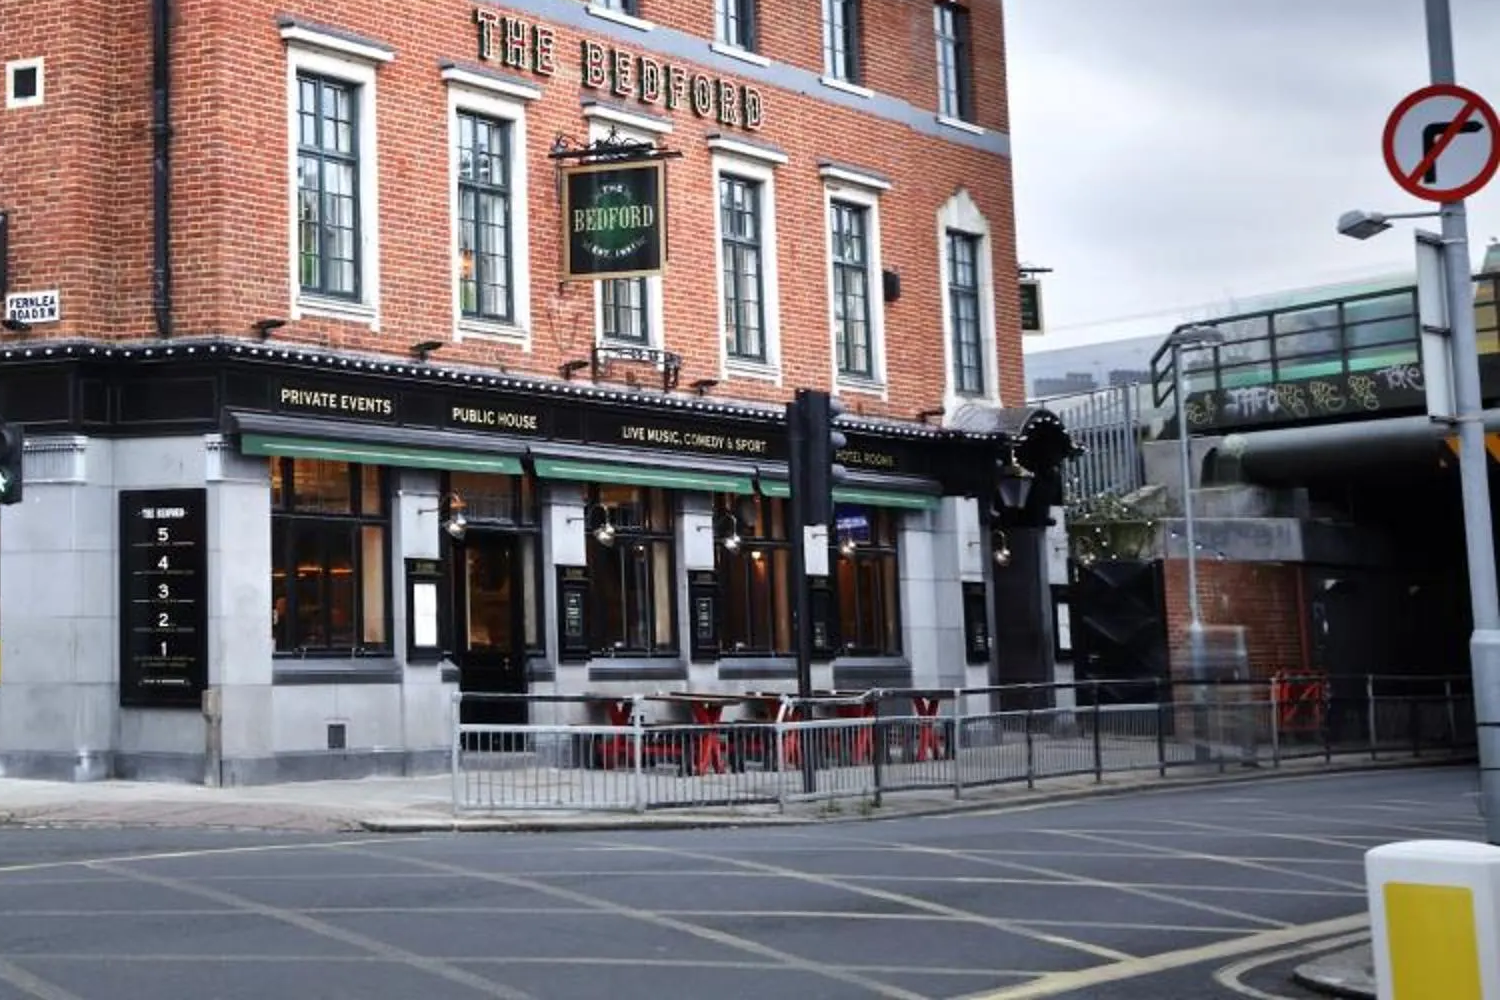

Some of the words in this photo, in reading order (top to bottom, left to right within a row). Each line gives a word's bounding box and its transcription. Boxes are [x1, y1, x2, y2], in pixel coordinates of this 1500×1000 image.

[477, 7, 556, 75] THE
[581, 39, 763, 131] BEDFORD
[573, 204, 654, 232] BEDFORD
[9, 295, 55, 309] FERNLEA
[281, 388, 337, 409] PRIVATE
[341, 395, 391, 415] EVENTS
[452, 407, 495, 425] PUBLIC
[498, 413, 537, 430] HOUSE
[621, 425, 645, 440] LIVE
[684, 432, 725, 450] COMEDY
[735, 438, 767, 453] SPORT
[157, 527, 169, 541] 5
[157, 555, 169, 570] 4
[157, 583, 169, 599] 3
[158, 612, 170, 627] 2
[161, 641, 167, 657] 1
